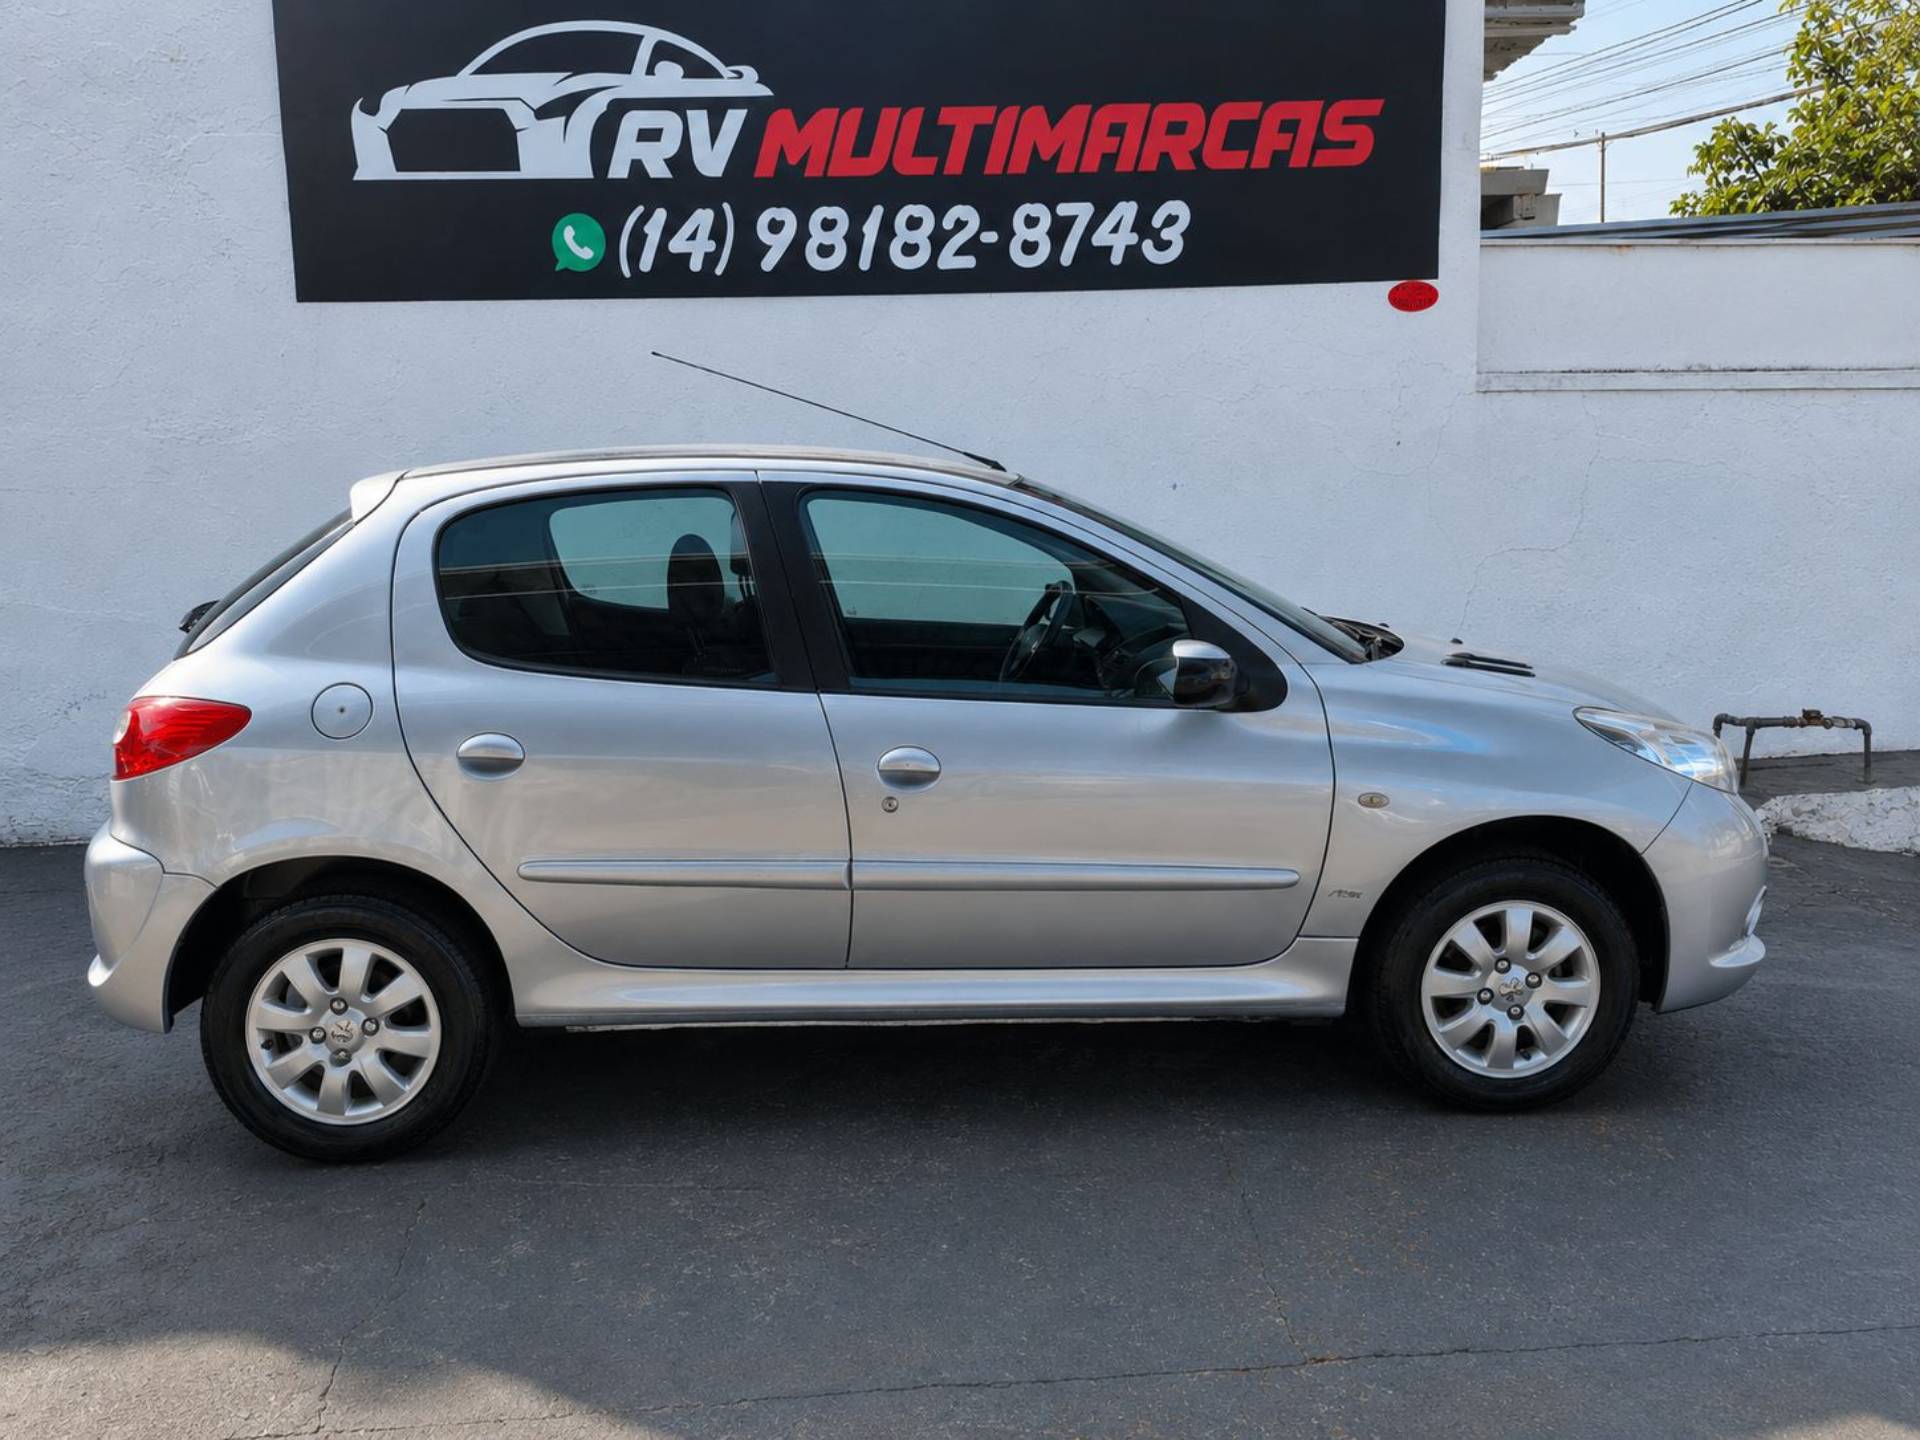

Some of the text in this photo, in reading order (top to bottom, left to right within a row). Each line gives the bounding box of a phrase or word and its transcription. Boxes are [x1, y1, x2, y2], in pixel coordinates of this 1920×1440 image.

[608, 99, 1384, 178] RV MULTIMARCAS
[619, 200, 1190, 278] (14) 98182-8743
